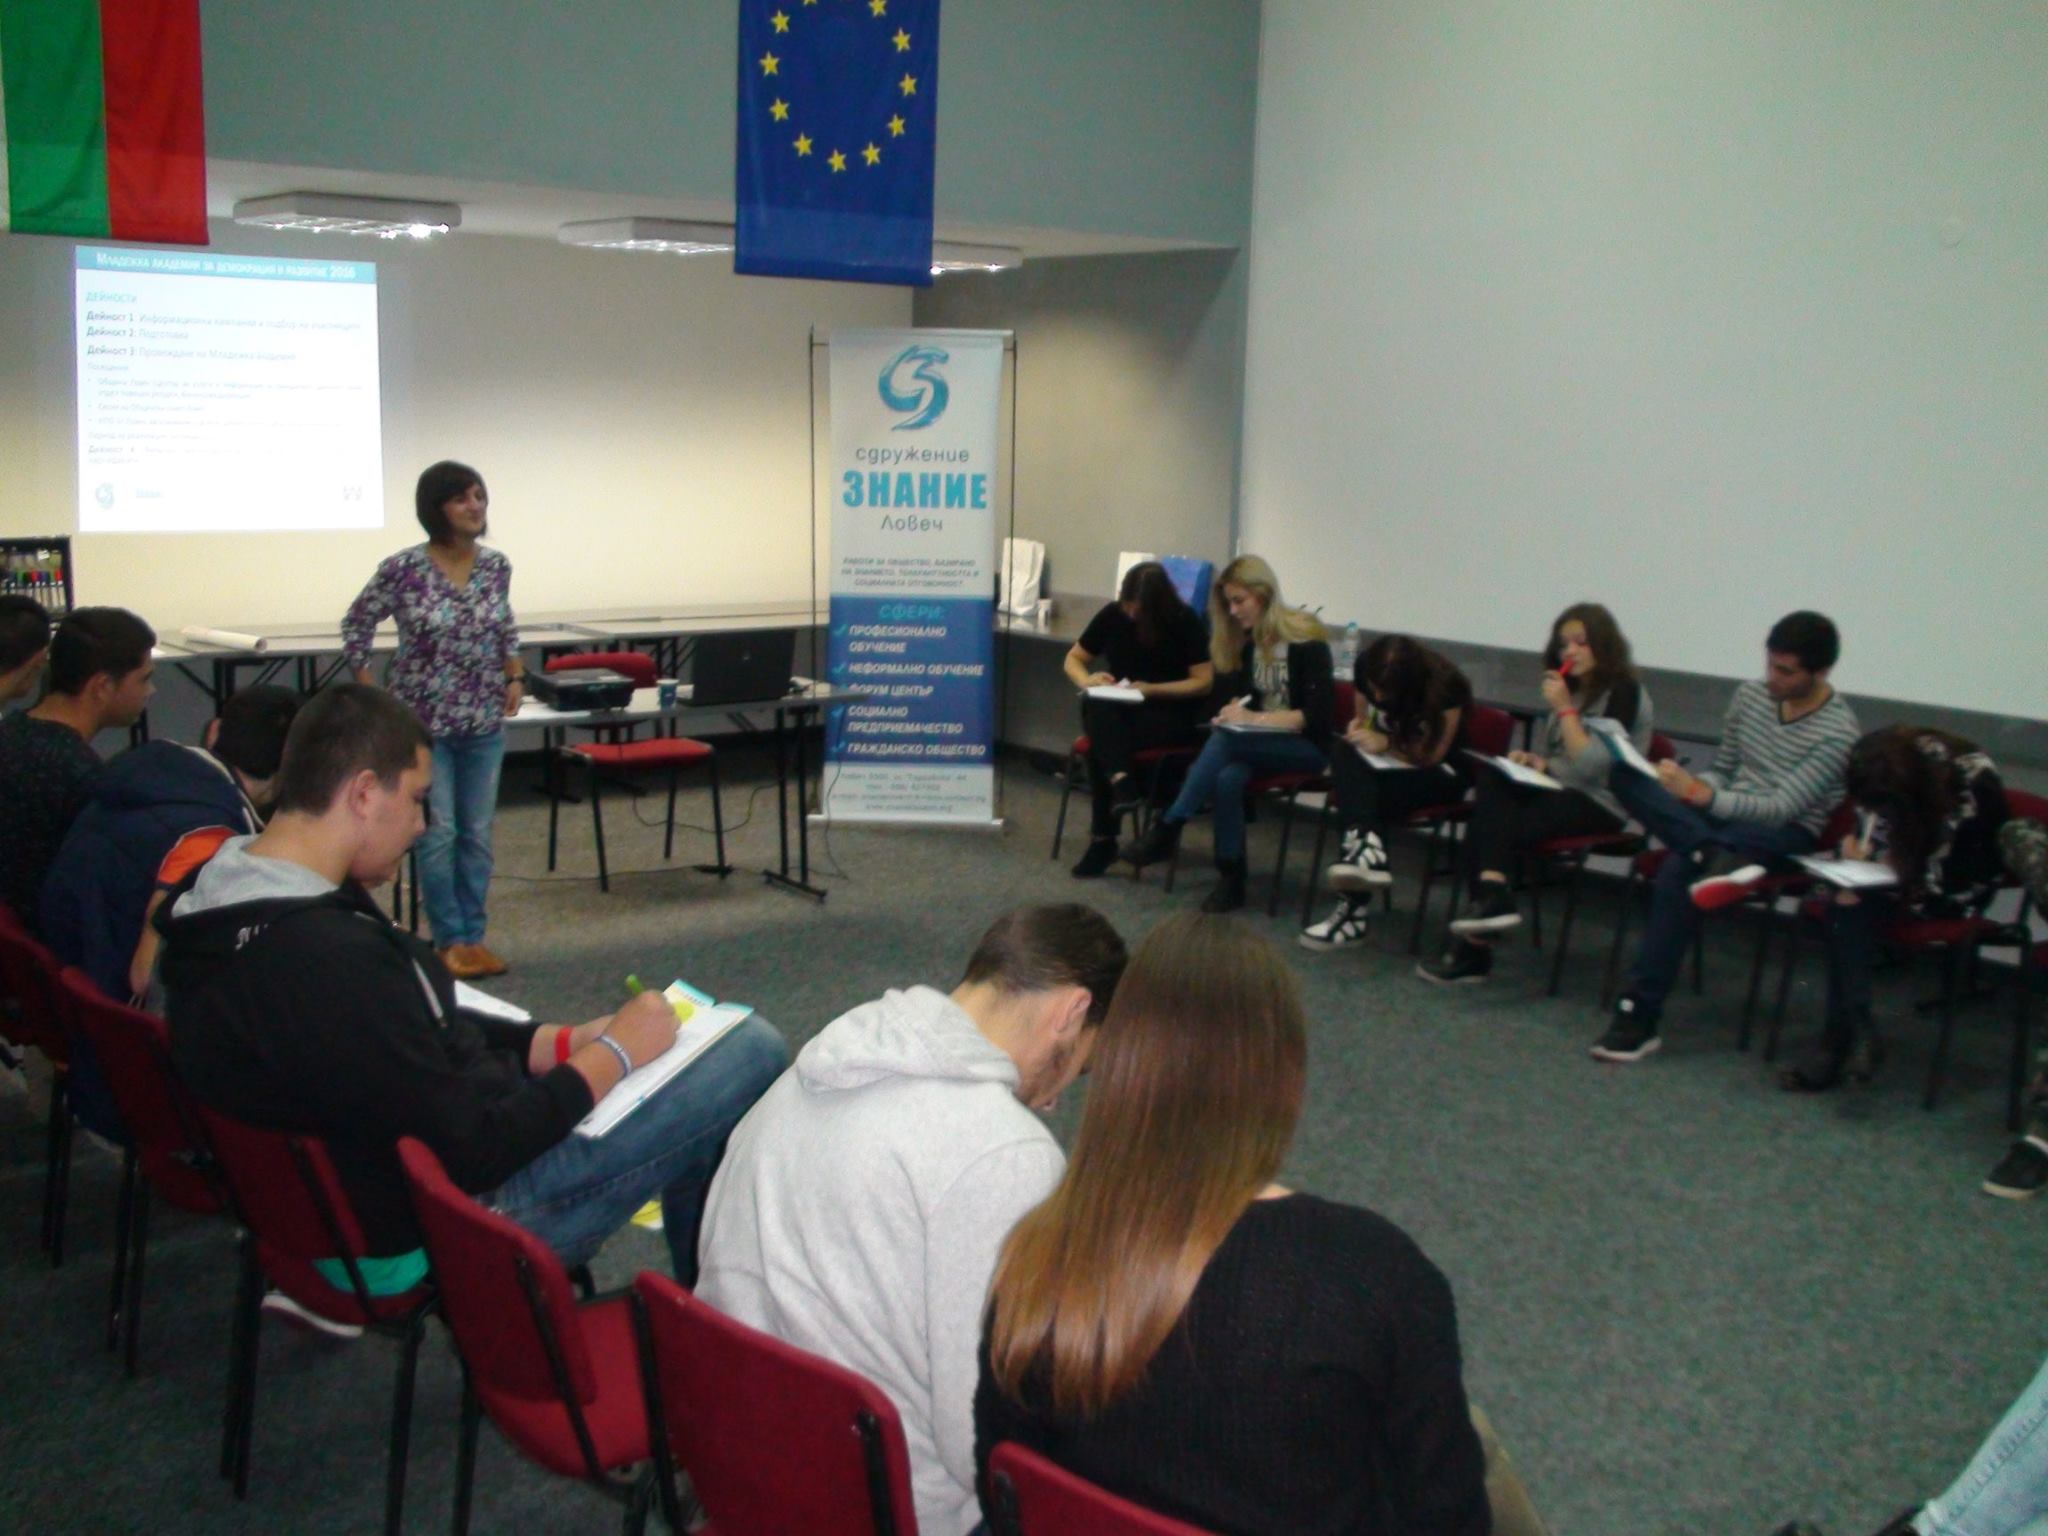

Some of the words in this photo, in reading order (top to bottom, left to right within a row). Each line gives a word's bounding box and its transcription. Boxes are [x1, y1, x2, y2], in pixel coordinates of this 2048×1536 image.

[87, 310, 126, 323] Дейност
[87, 325, 126, 337] Дейност
[87, 344, 126, 356] Дейност
[856, 445, 970, 465] сдружение
[842, 470, 987, 509] ЗНАНИЕ
[881, 514, 943, 532] Ловеч
[849, 624, 946, 637] ПРОФЕСИОНАЛНО
[849, 641, 907, 653] ОБУЧЕНИЕ
[849, 662, 925, 675] НЕФОРМАЛНО
[928, 664, 984, 676] ОБУЧЕНИЕ
[892, 684, 934, 697] ЦЕНТЪР
[848, 705, 908, 717] СОЦИАЛНО
[848, 722, 963, 734] ПРЕДПРИЕМАЧЕСТВО
[848, 743, 924, 755] ГРАЖДАНСКО
[926, 744, 986, 756] ОБЩЕСТВО
